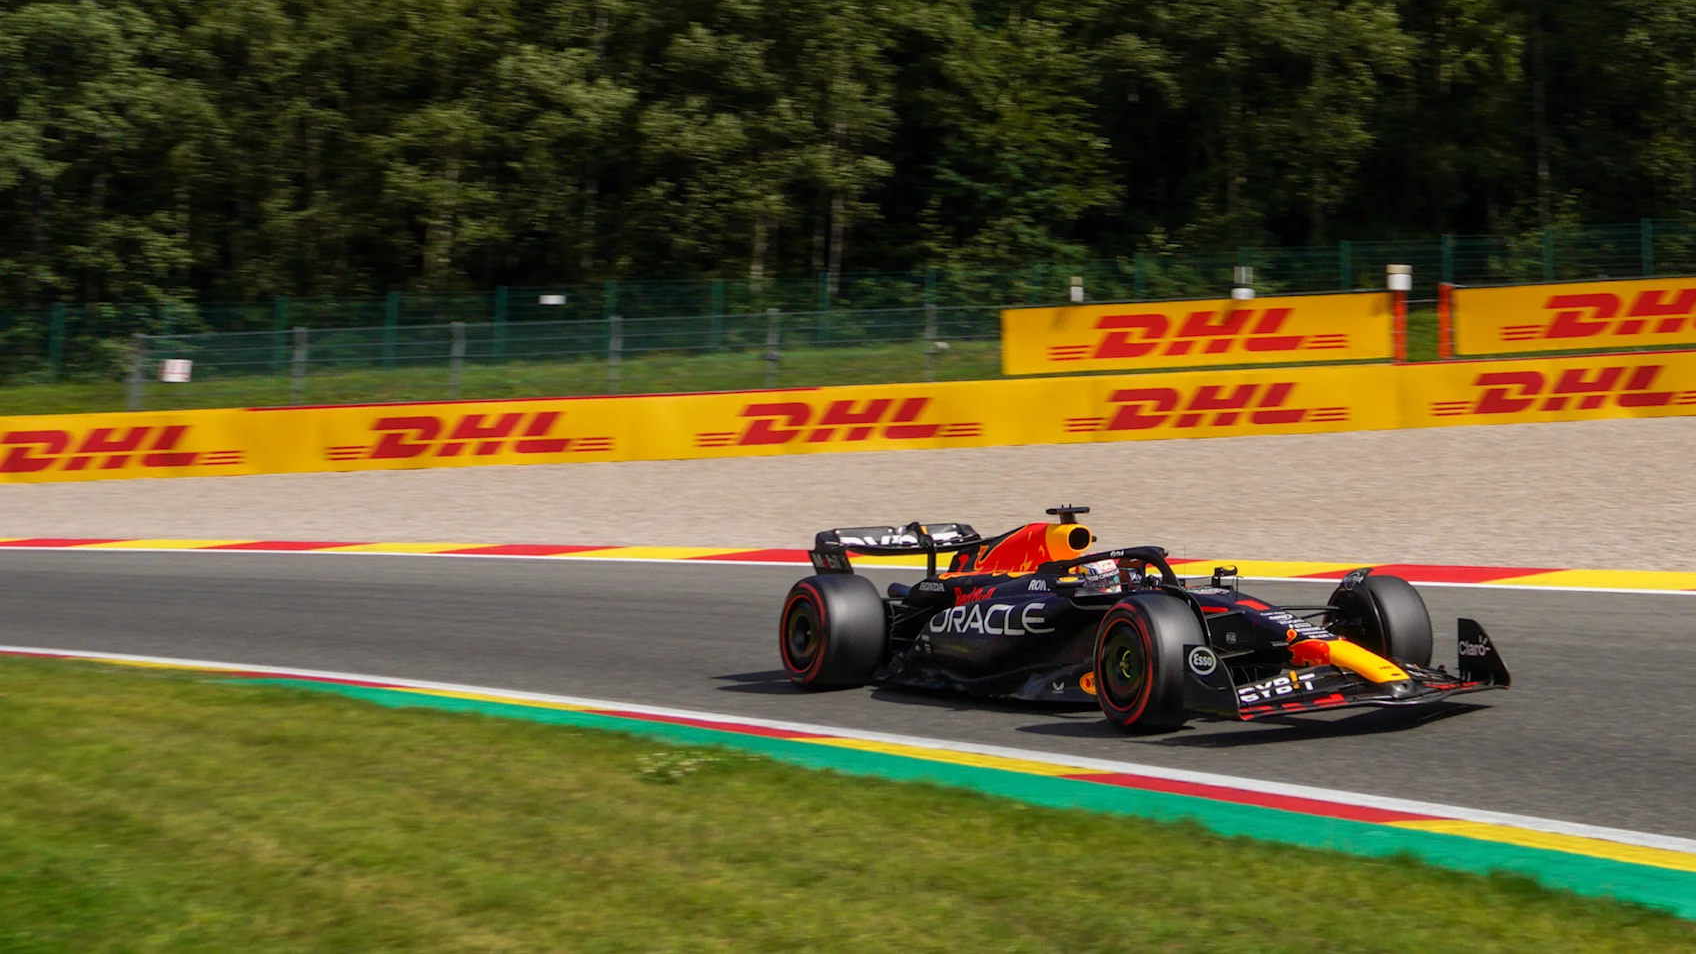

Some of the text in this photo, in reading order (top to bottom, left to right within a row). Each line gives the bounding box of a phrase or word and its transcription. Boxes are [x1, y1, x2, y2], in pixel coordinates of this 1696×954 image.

[1092, 307, 1306, 359] DHL
[1106, 382, 1308, 431] DHL
[1473, 365, 1675, 415] DHL
[369, 411, 572, 459] DHL
[738, 397, 941, 446] DHL
[0, 425, 199, 473] DHL
[919, 582, 946, 592] HONDA
[929, 603, 1056, 636] ORACLE
[1193, 654, 1213, 667] Esso
